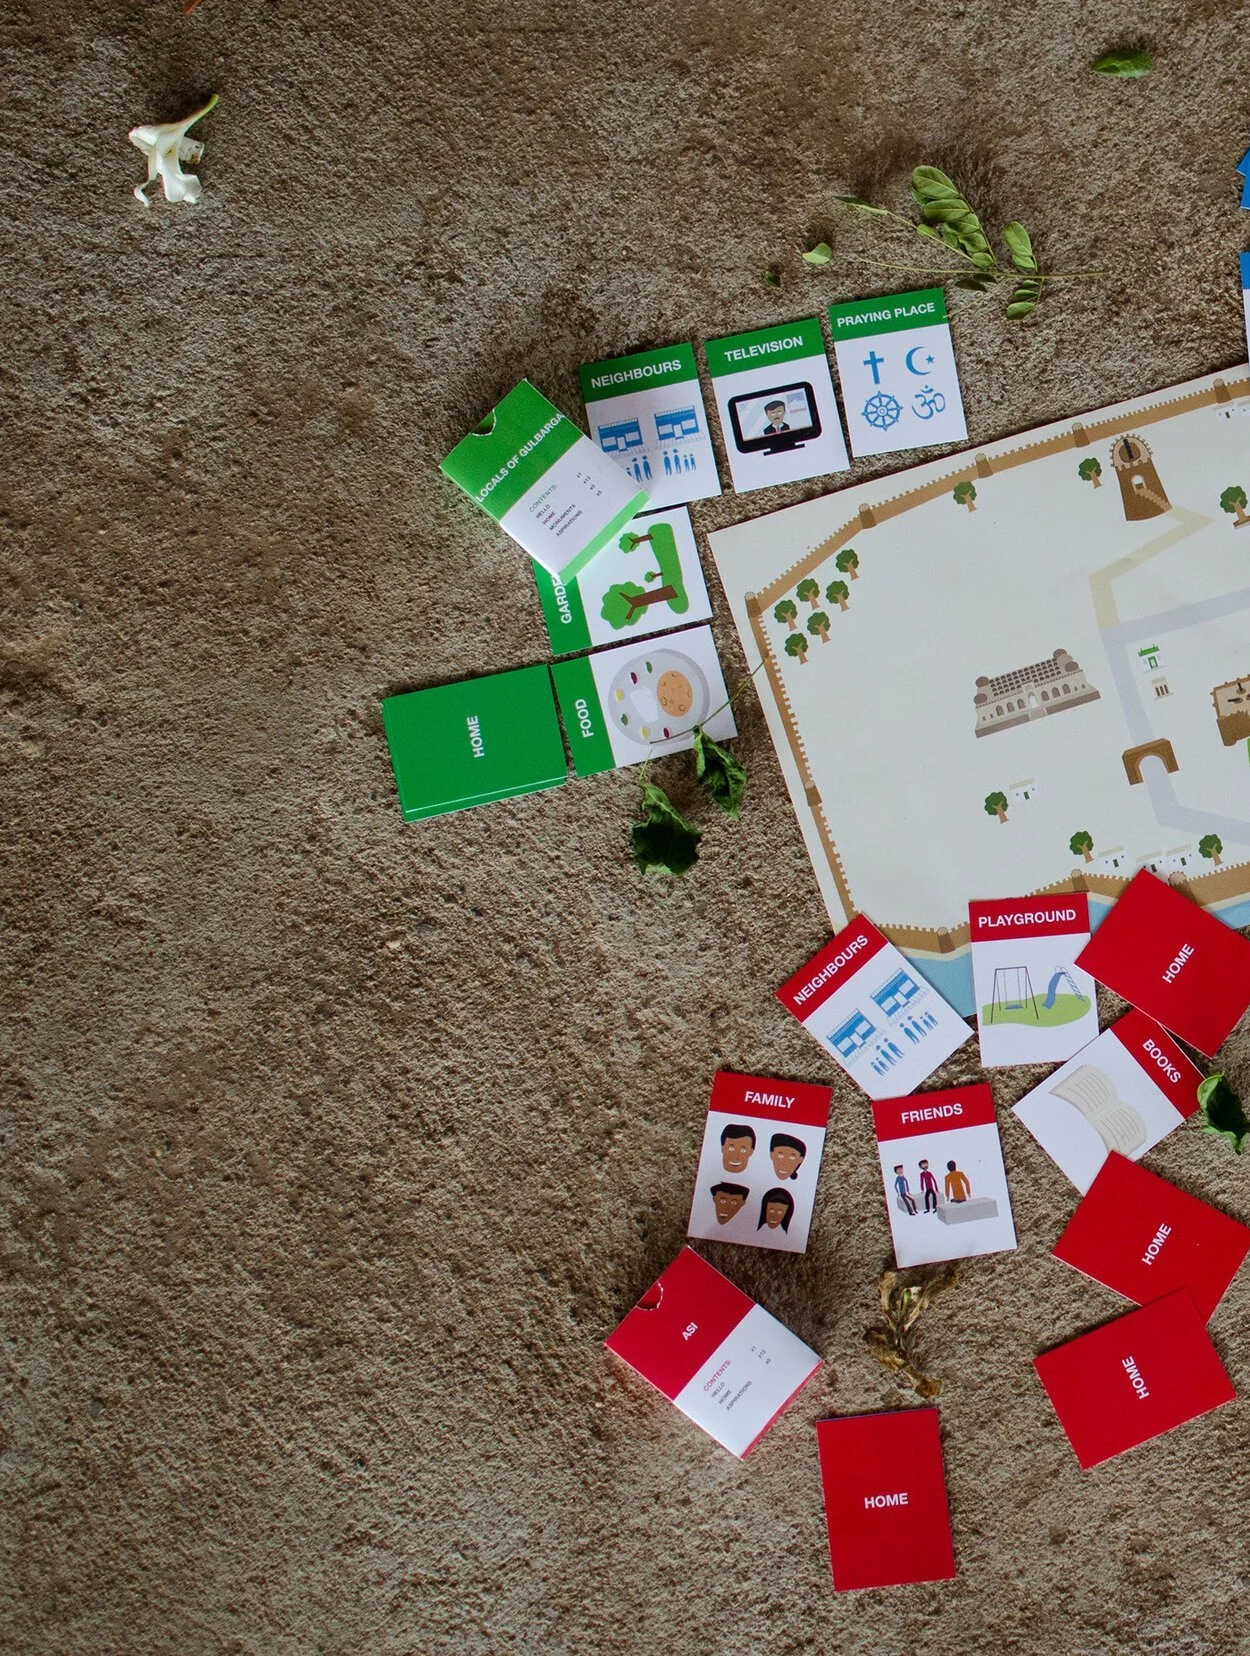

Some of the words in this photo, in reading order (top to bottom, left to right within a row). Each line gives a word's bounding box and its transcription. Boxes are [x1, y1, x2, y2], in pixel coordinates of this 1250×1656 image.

[837, 310, 891, 328] PRAYING
[894, 303, 935, 317] PLACE
[724, 336, 802, 361] TELEVISION
[592, 360, 681, 387] NEIGHBOURS
[476, 467, 509, 502] LOCALS
[507, 455, 520, 470] OF
[519, 412, 566, 457] GULBARGA
[535, 504, 551, 519] HELLO
[541, 510, 557, 525] HOME
[548, 503, 576, 531] MONUMENTS
[556, 510, 583, 537] ASPIRATIONS
[552, 576, 573, 624] GARDE
[581, 700, 593, 737] FOOD
[468, 716, 484, 757] HOME
[979, 910, 1076, 927] PLAYGROUND
[793, 935, 867, 1005] NEIGHBOURS
[1162, 944, 1194, 983] HOME
[1143, 1039, 1180, 1082] BOOKS
[745, 1091, 795, 1108] FAMILY
[902, 1104, 962, 1123] FRIENDS
[1142, 1224, 1171, 1265] HOME
[683, 1322, 698, 1340] ASI
[710, 1382, 725, 1398] HELLO
[1122, 1356, 1149, 1399] HOME
[717, 1389, 732, 1404] HOME
[726, 1380, 752, 1411] ASPIRATIONS
[865, 1493, 908, 1508] HOME
